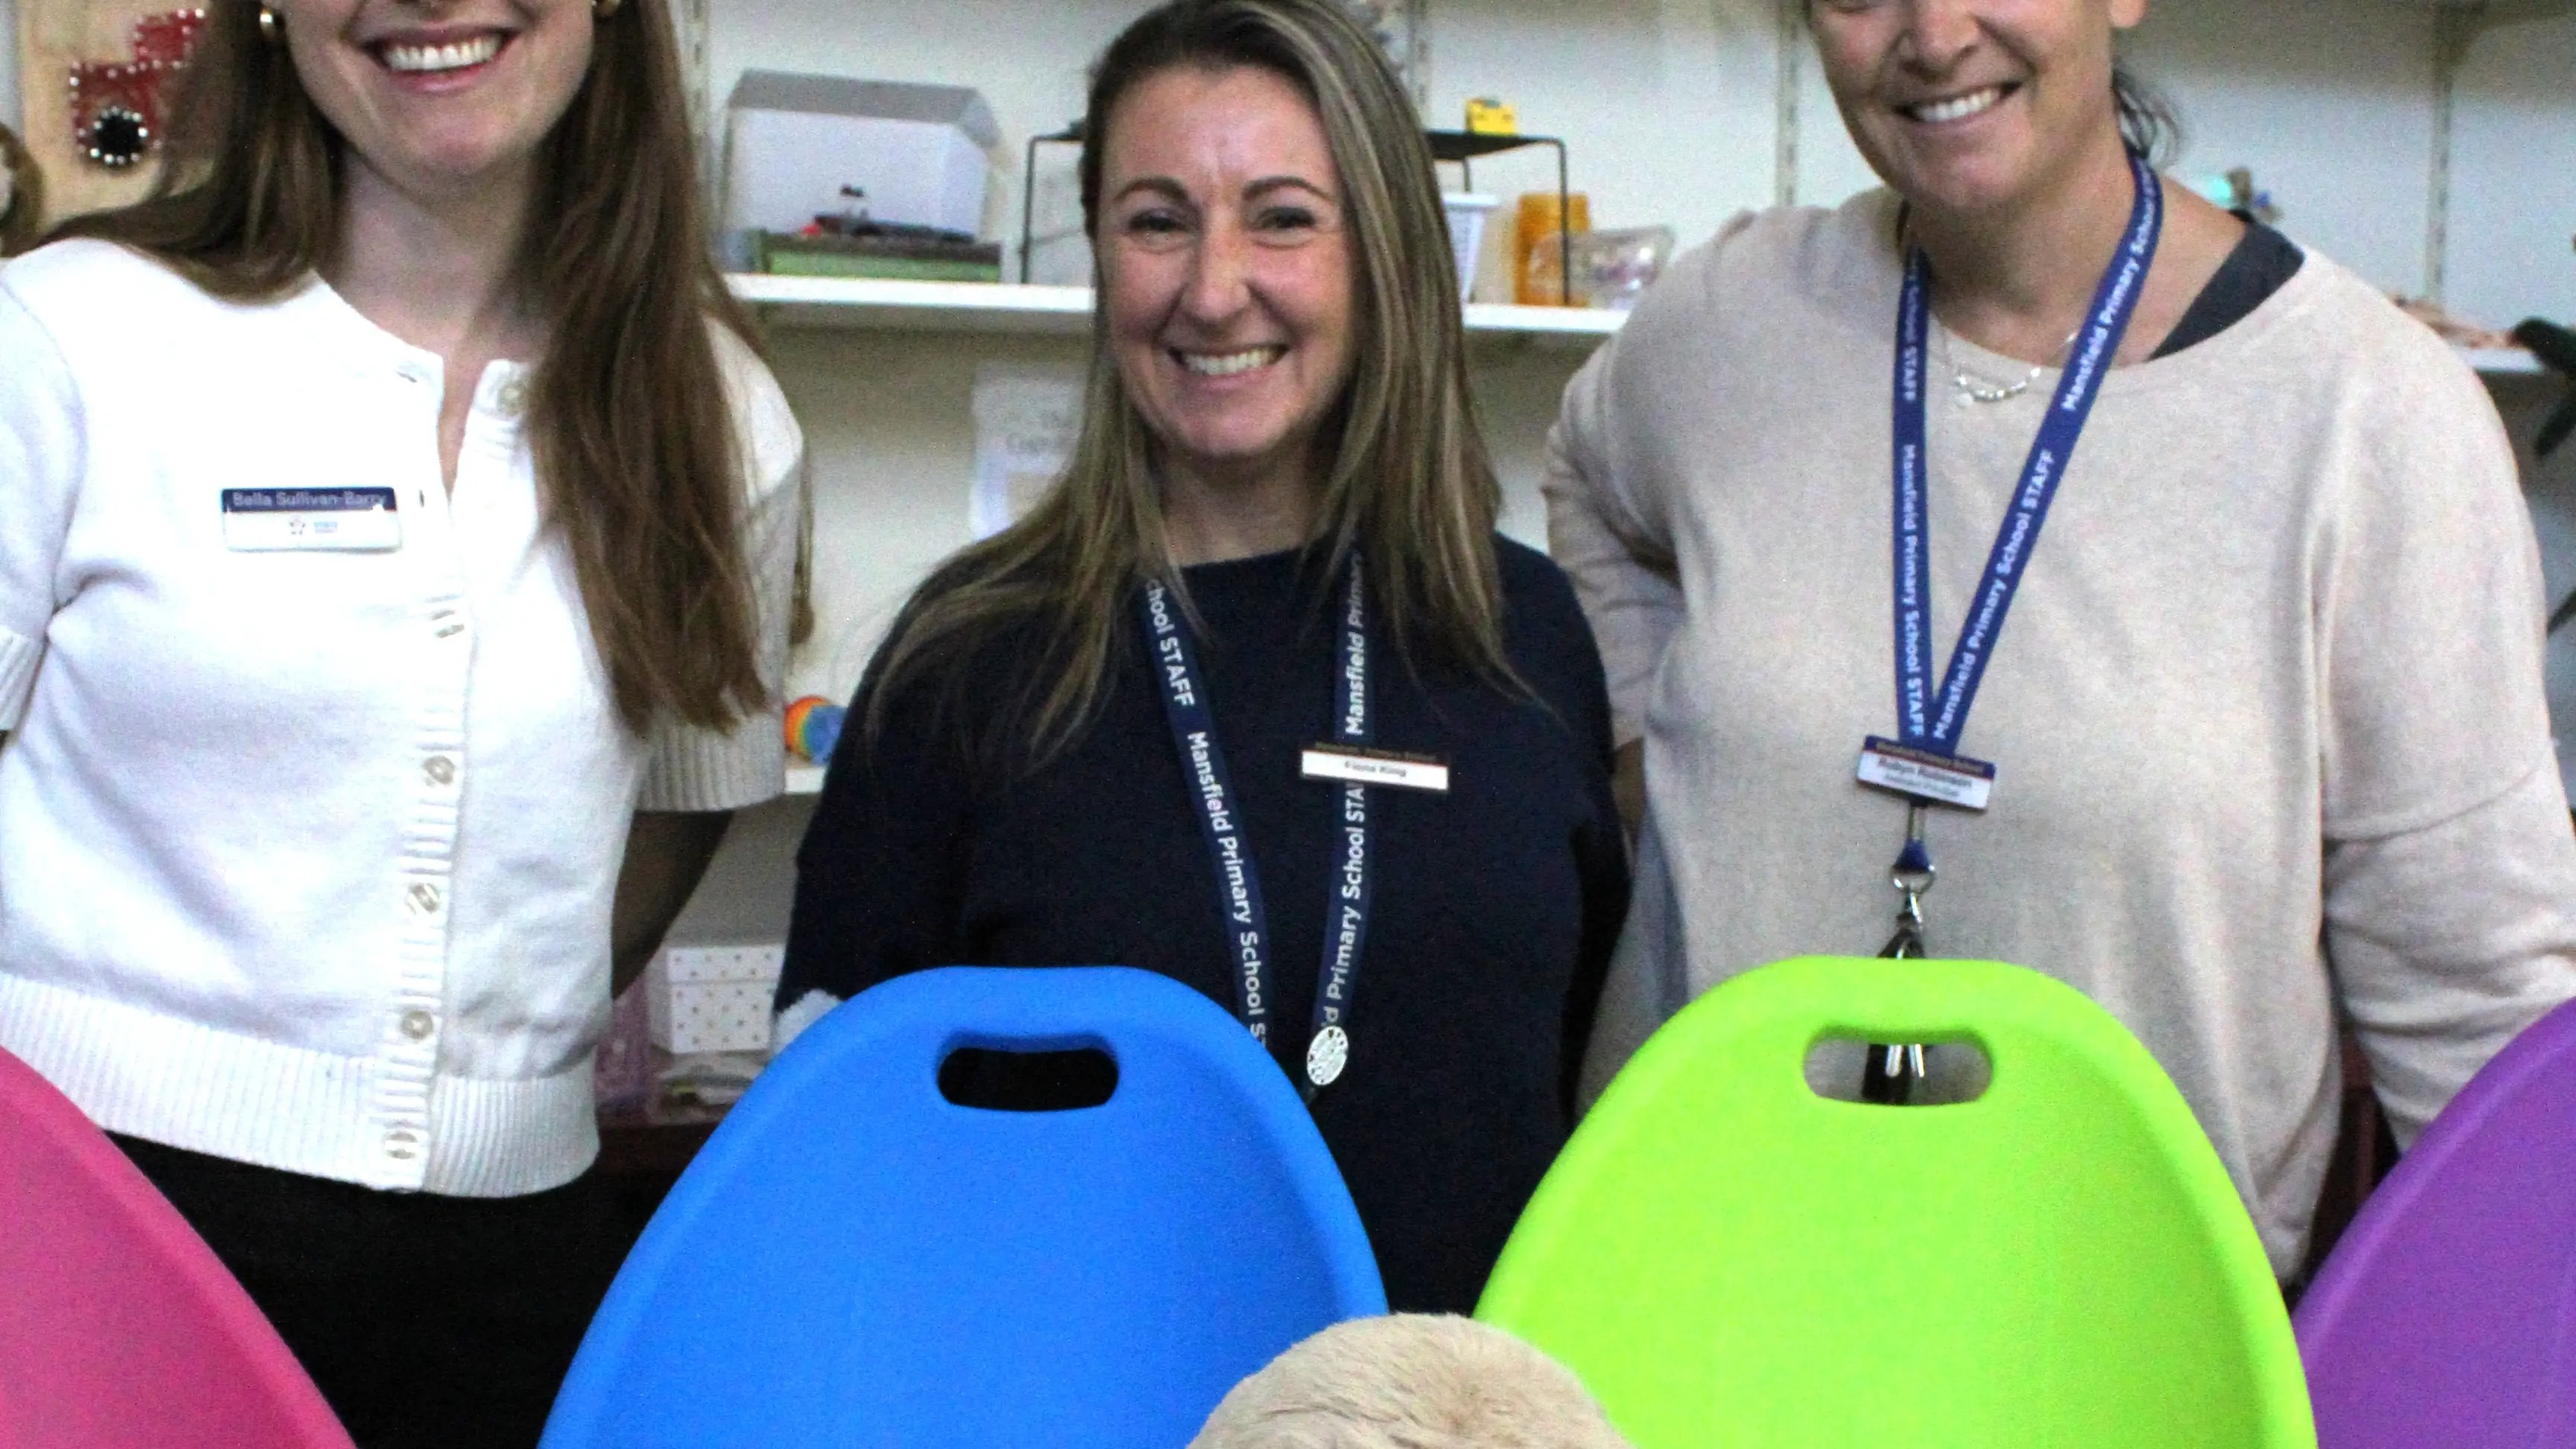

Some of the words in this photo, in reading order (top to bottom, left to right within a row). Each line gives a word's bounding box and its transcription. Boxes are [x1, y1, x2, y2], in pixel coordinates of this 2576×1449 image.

[2061, 325, 2108, 411] Mansfield
[2098, 256, 2140, 326] Primary
[1903, 346, 1918, 402] STAFF
[232, 491, 273, 507] Bella
[276, 490, 388, 508] Sullivan-Barry
[1902, 444, 1917, 531] Mansfield
[1902, 535, 1919, 606] Primary
[1933, 651, 1977, 740] Mansfield
[1966, 578, 2007, 649] Primary
[1995, 511, 2033, 575] School
[2021, 448, 2055, 509] STAFF
[1146, 579, 1175, 634] chool
[1904, 610, 1920, 674] School
[1160, 637, 1196, 707] STAFF
[1345, 631, 1366, 736] Mansfield
[1907, 678, 1925, 737] STAFF
[1345, 781, 1365, 823] STA
[1187, 731, 1234, 833] Mansfield
[1218, 836, 1252, 924] Primary
[1240, 931, 1266, 1016] School
[1342, 827, 1365, 900] School
[1326, 906, 1362, 1000] Primary
